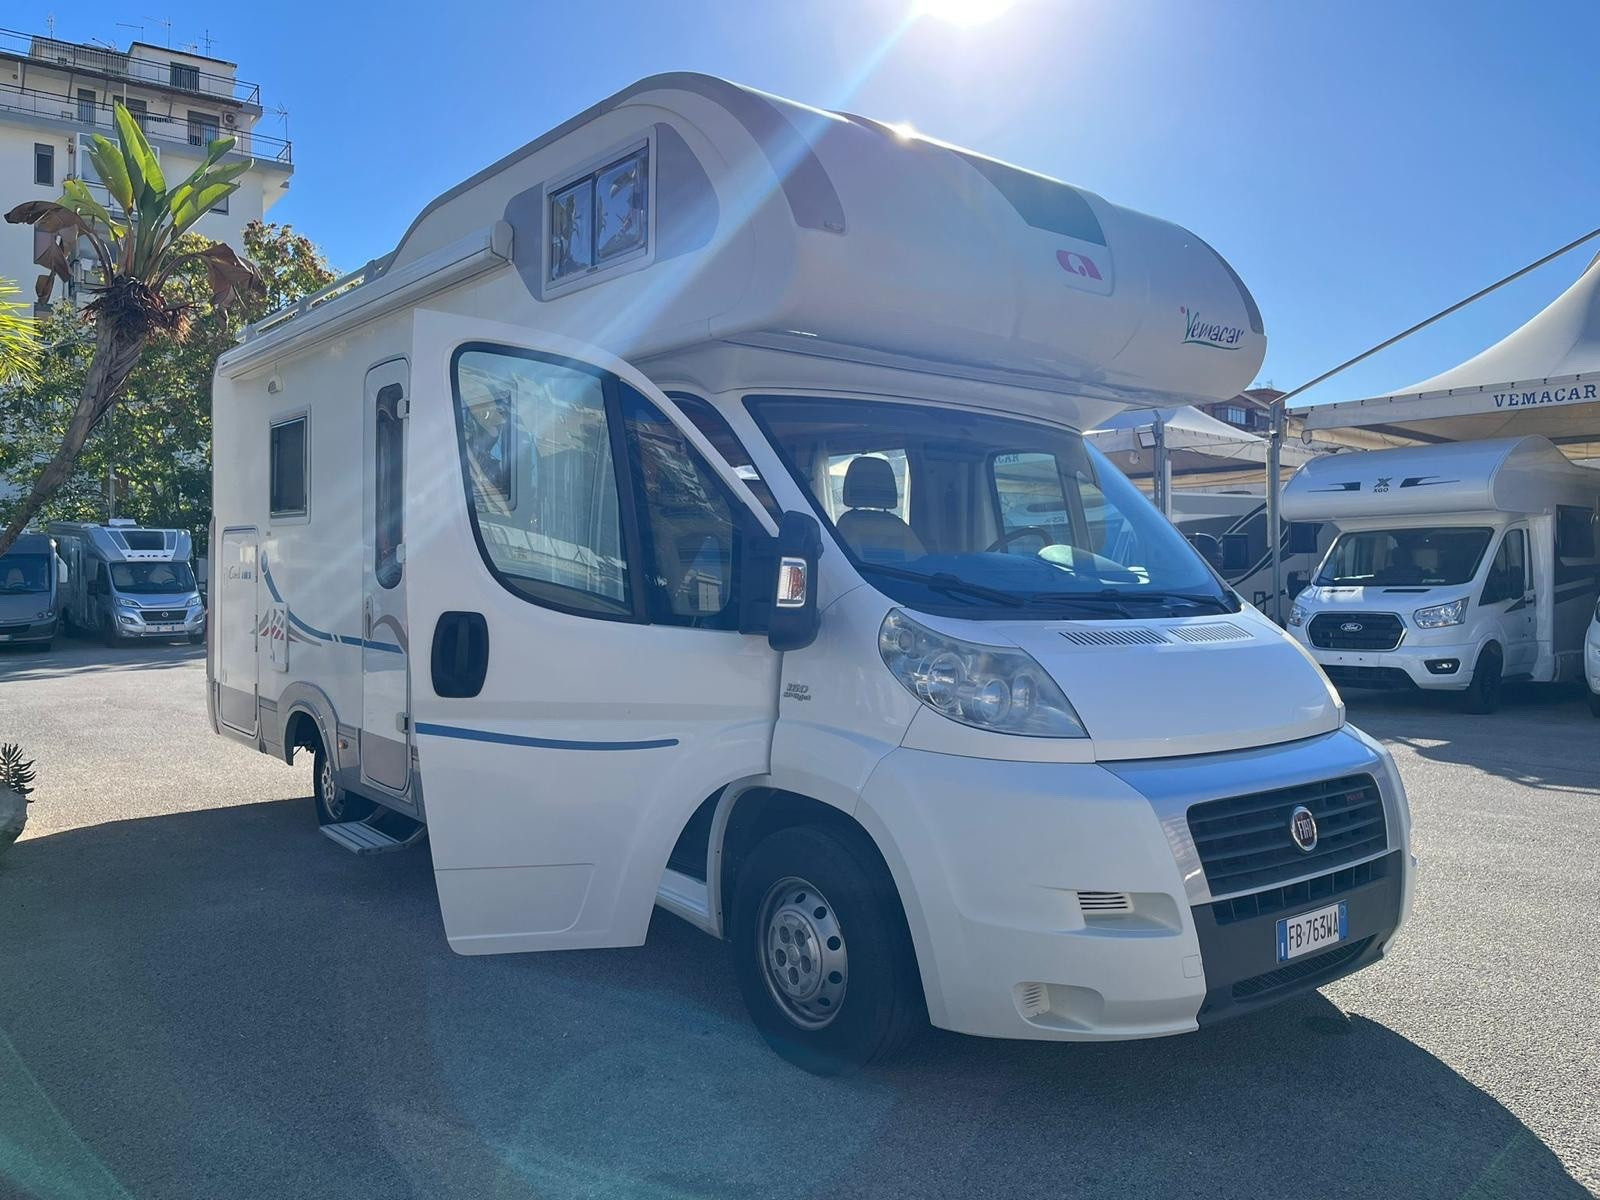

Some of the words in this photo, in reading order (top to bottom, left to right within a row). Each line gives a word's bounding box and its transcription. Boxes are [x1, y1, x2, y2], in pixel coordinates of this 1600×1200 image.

[1184, 308, 1244, 344] Vemacar
[1493, 384, 1597, 408] VEMACAR
[1297, 818, 1313, 840] FIAT
